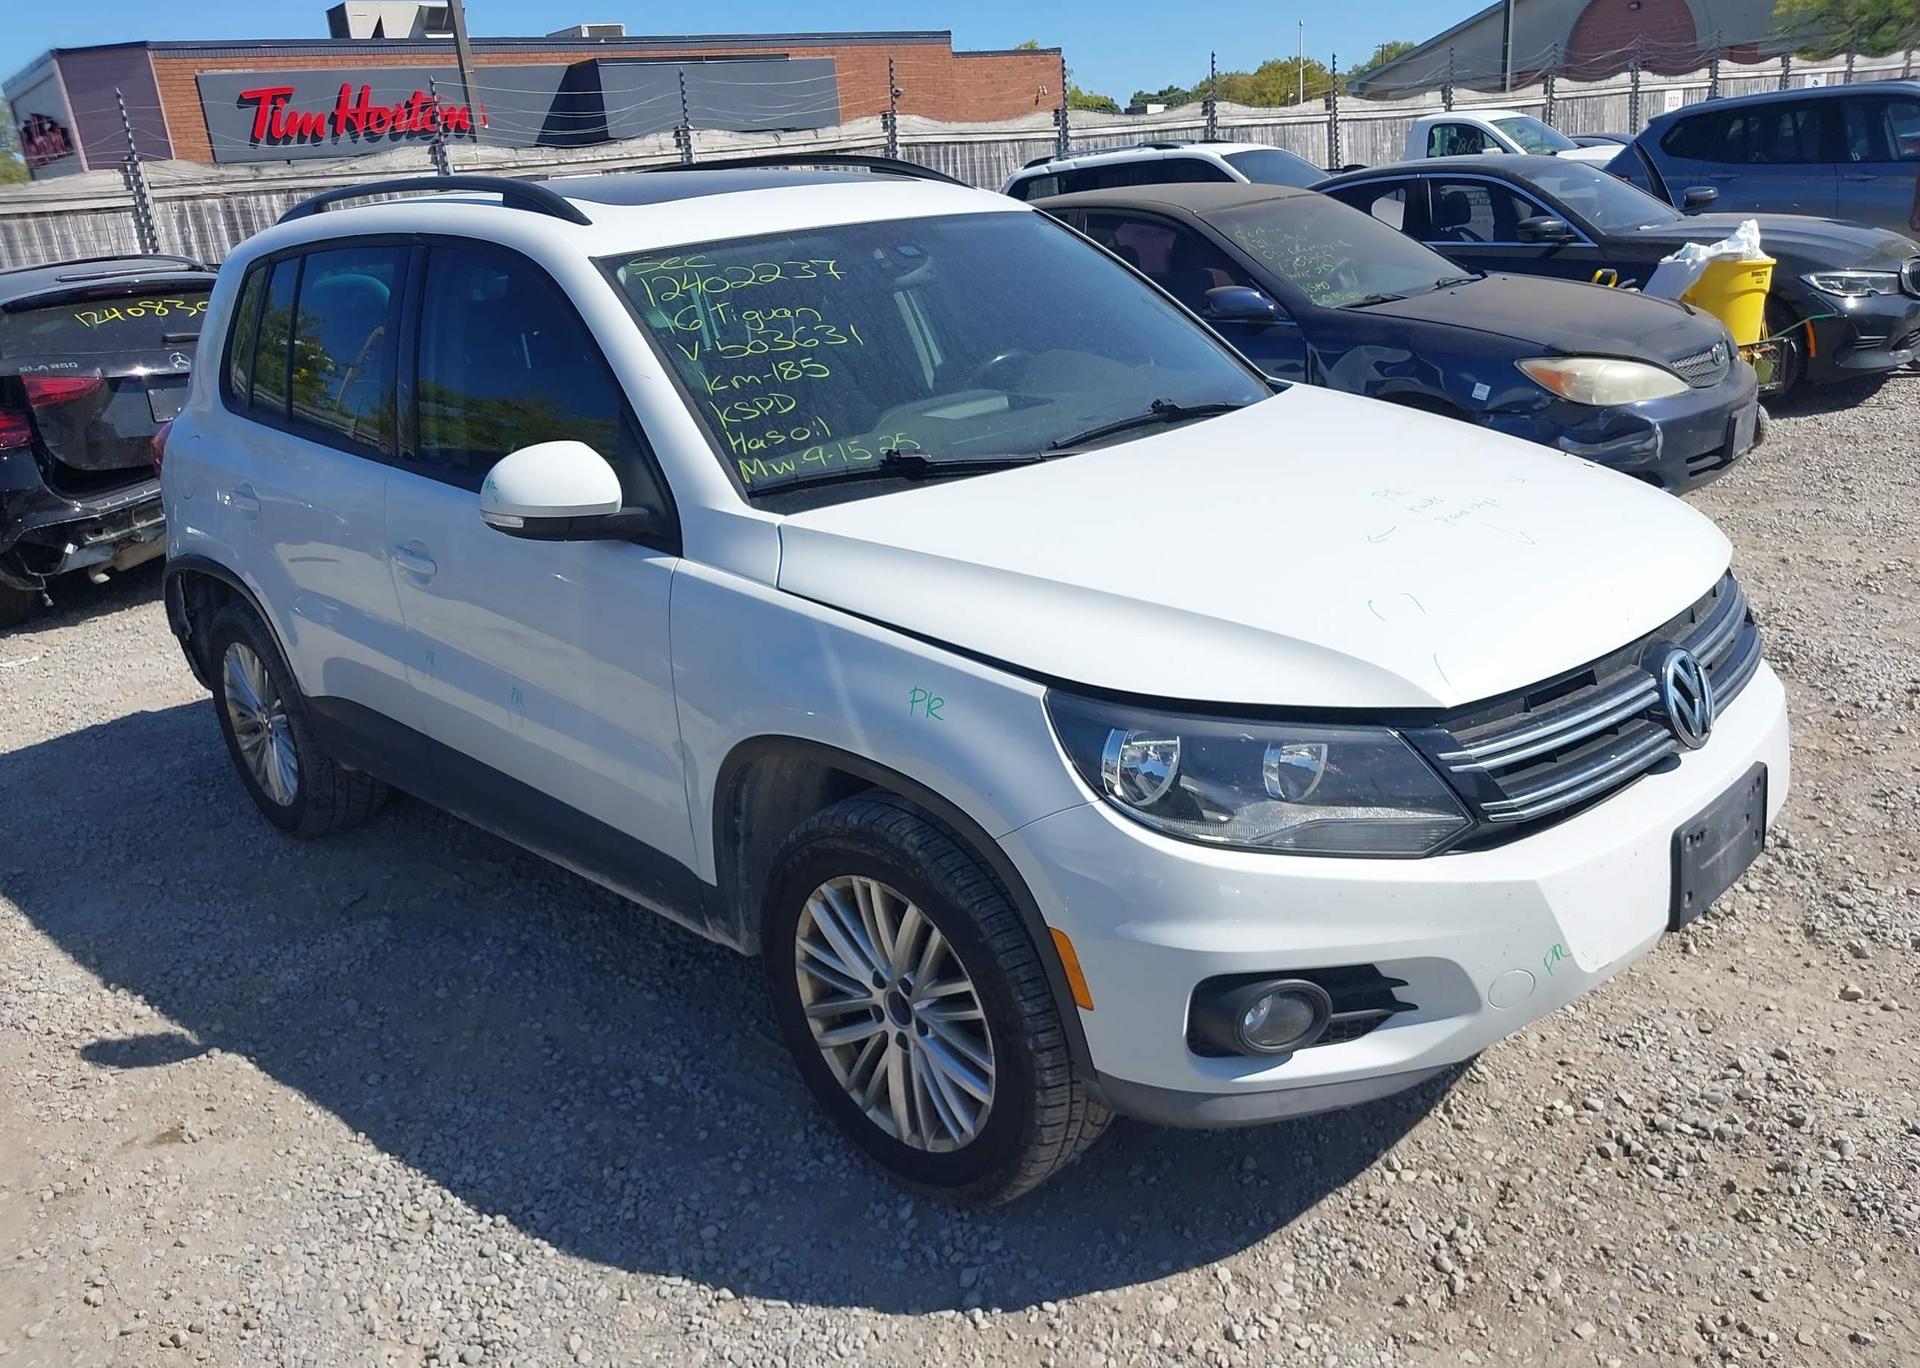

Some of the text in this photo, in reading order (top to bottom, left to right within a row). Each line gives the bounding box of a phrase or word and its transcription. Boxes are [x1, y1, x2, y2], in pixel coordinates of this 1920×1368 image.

[242, 83, 488, 139] Tim Horton
[640, 259, 846, 307] 12402237
[657, 302, 822, 335] 16 Tiguan
[709, 392, 797, 429] KSPD
[725, 430, 786, 455] Has
[910, 685, 945, 721] PR
